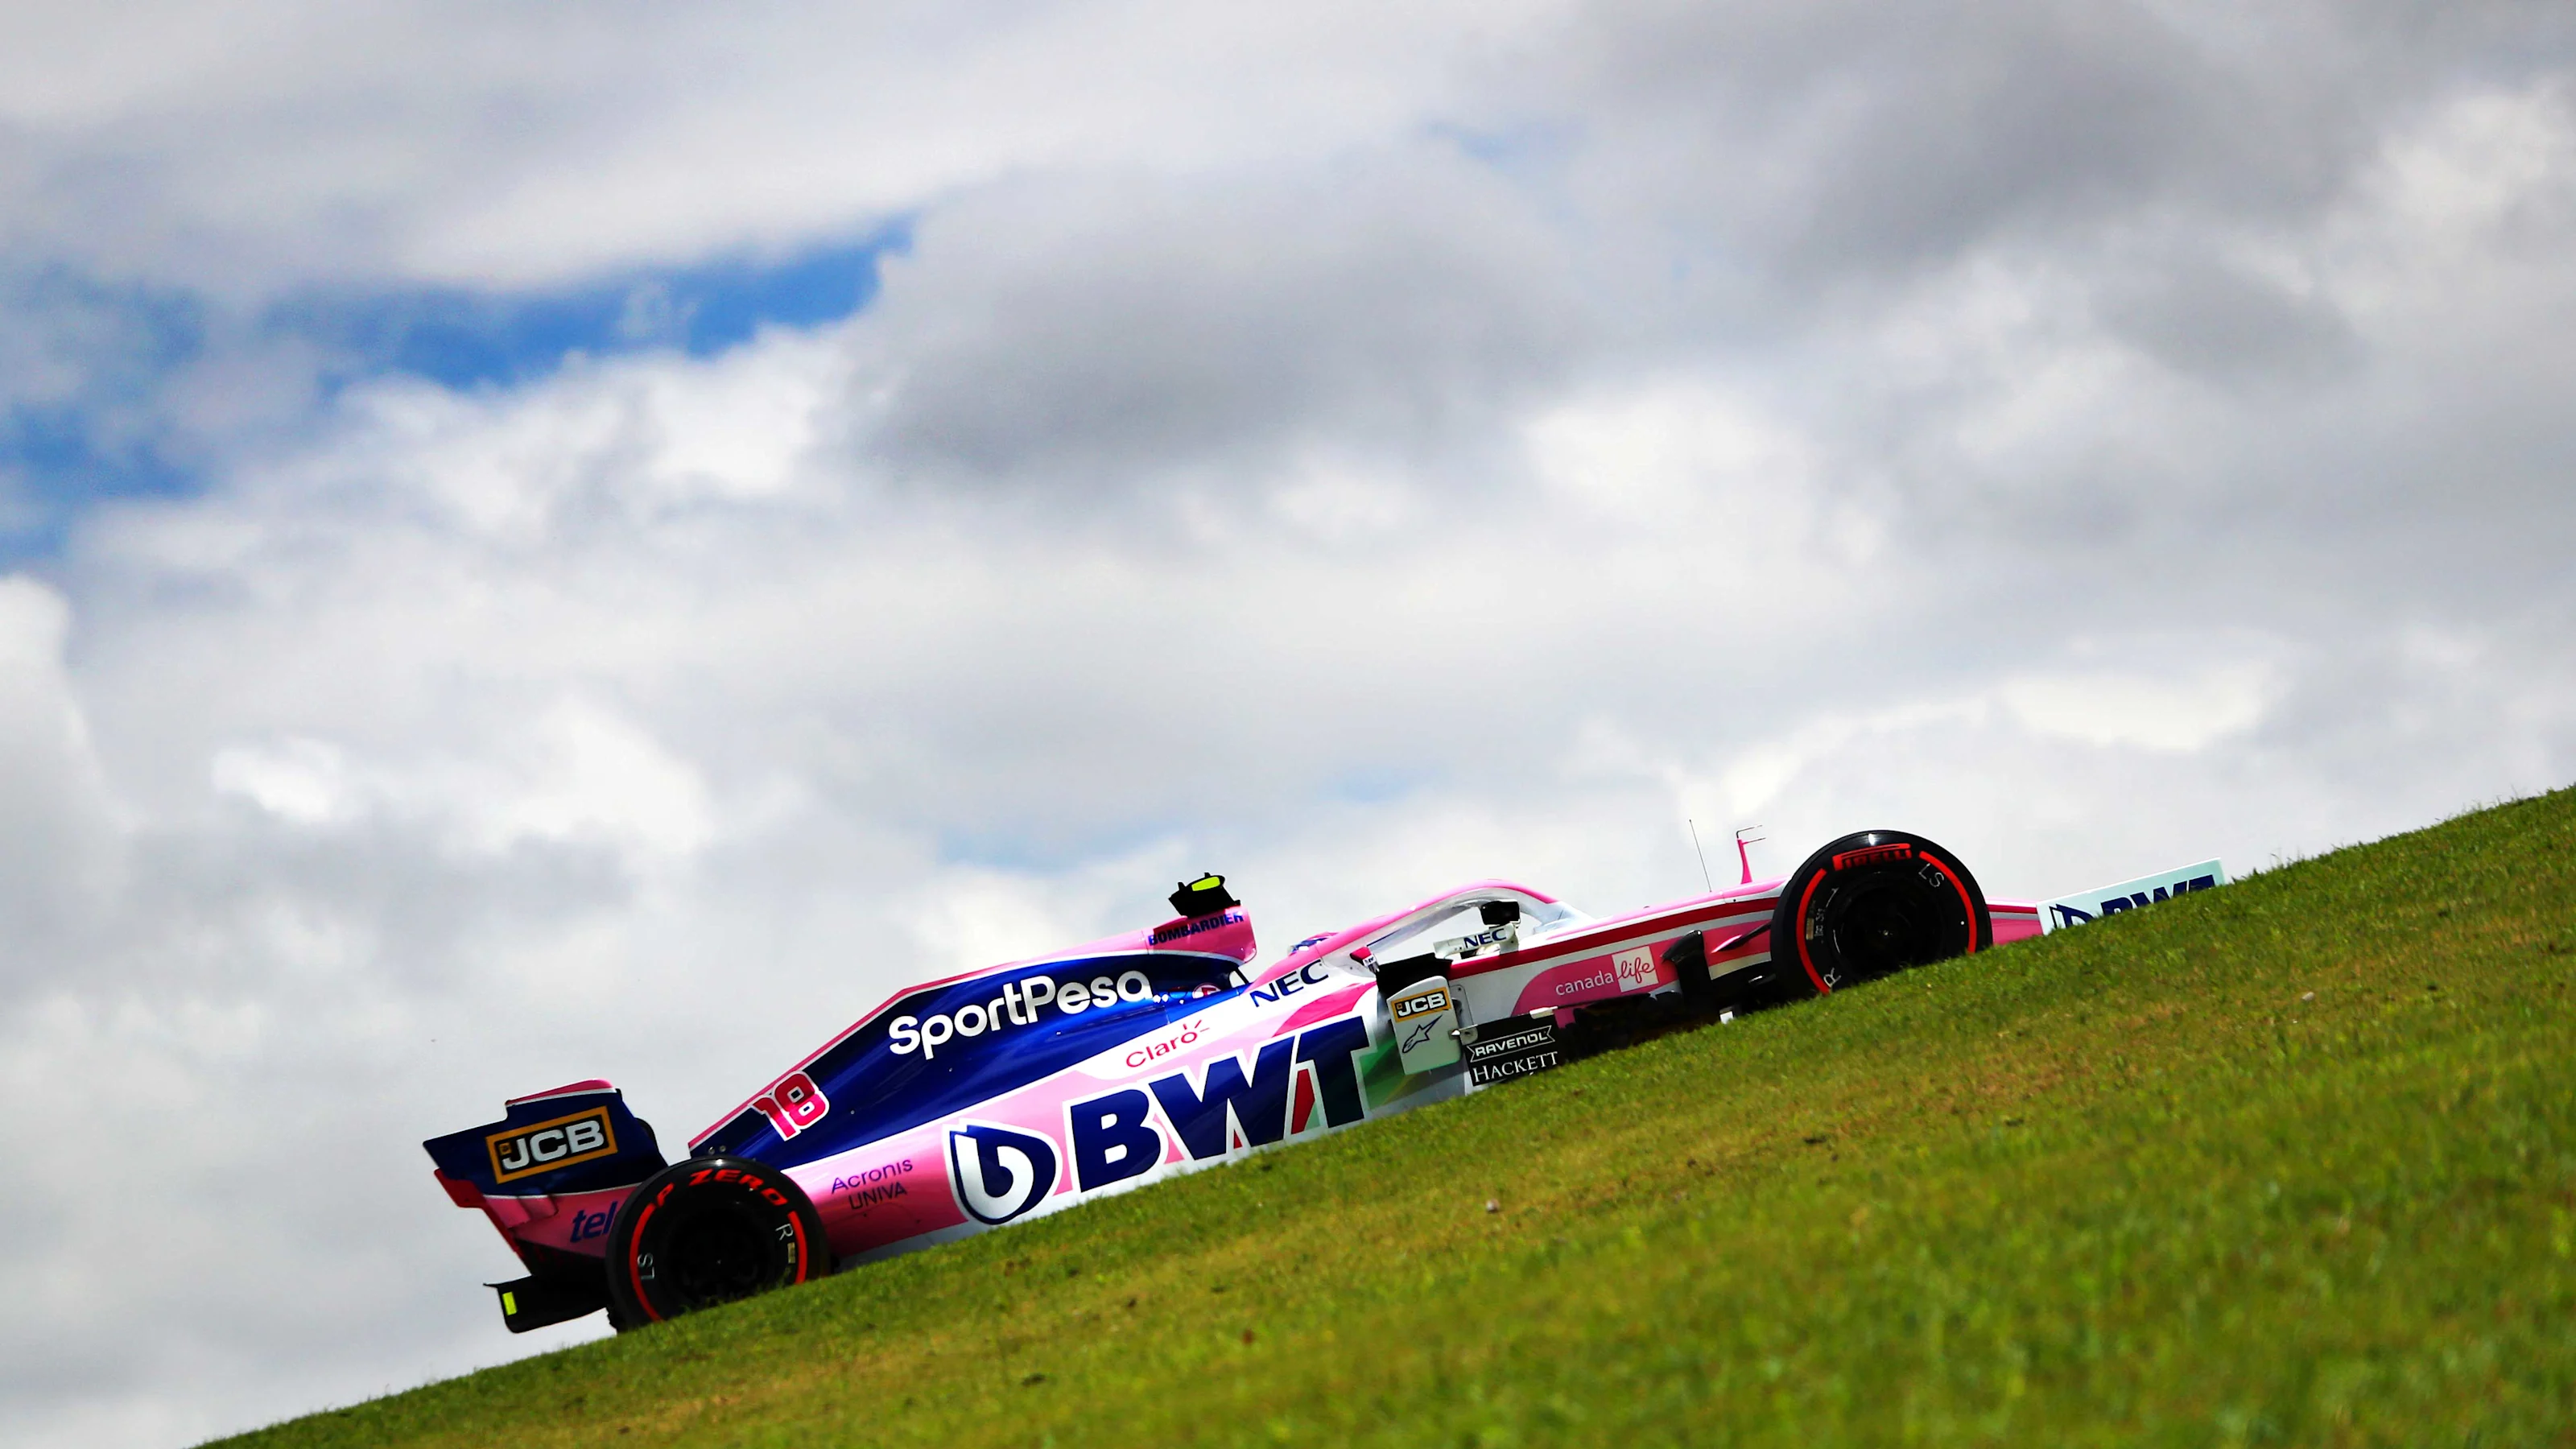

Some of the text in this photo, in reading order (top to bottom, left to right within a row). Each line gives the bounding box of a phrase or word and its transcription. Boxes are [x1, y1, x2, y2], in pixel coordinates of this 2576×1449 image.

[1832, 843, 1912, 871] PIRELLI
[1148, 911, 1244, 946] BOMBARDIER
[1463, 928, 1507, 949] NEC
[1249, 960, 1328, 1007] NEC
[1555, 957, 1655, 996] canada life
[1823, 968, 1841, 988] R
[889, 970, 1150, 1059] SportPesa
[1397, 993, 1447, 1018] JCB
[1126, 1029, 1198, 1068] Claro
[1476, 1031, 1548, 1057] RAVENOL
[1472, 1051, 1558, 1083] HACKETT
[750, 1071, 829, 1140] 18
[1070, 1014, 1368, 1193] BWT
[502, 1120, 605, 1170] JCB
[657, 1168, 789, 1208] P ZERO
[832, 1159, 913, 1194] Acronis
[848, 1182, 907, 1210] UNIVA
[775, 1223, 794, 1241] R
